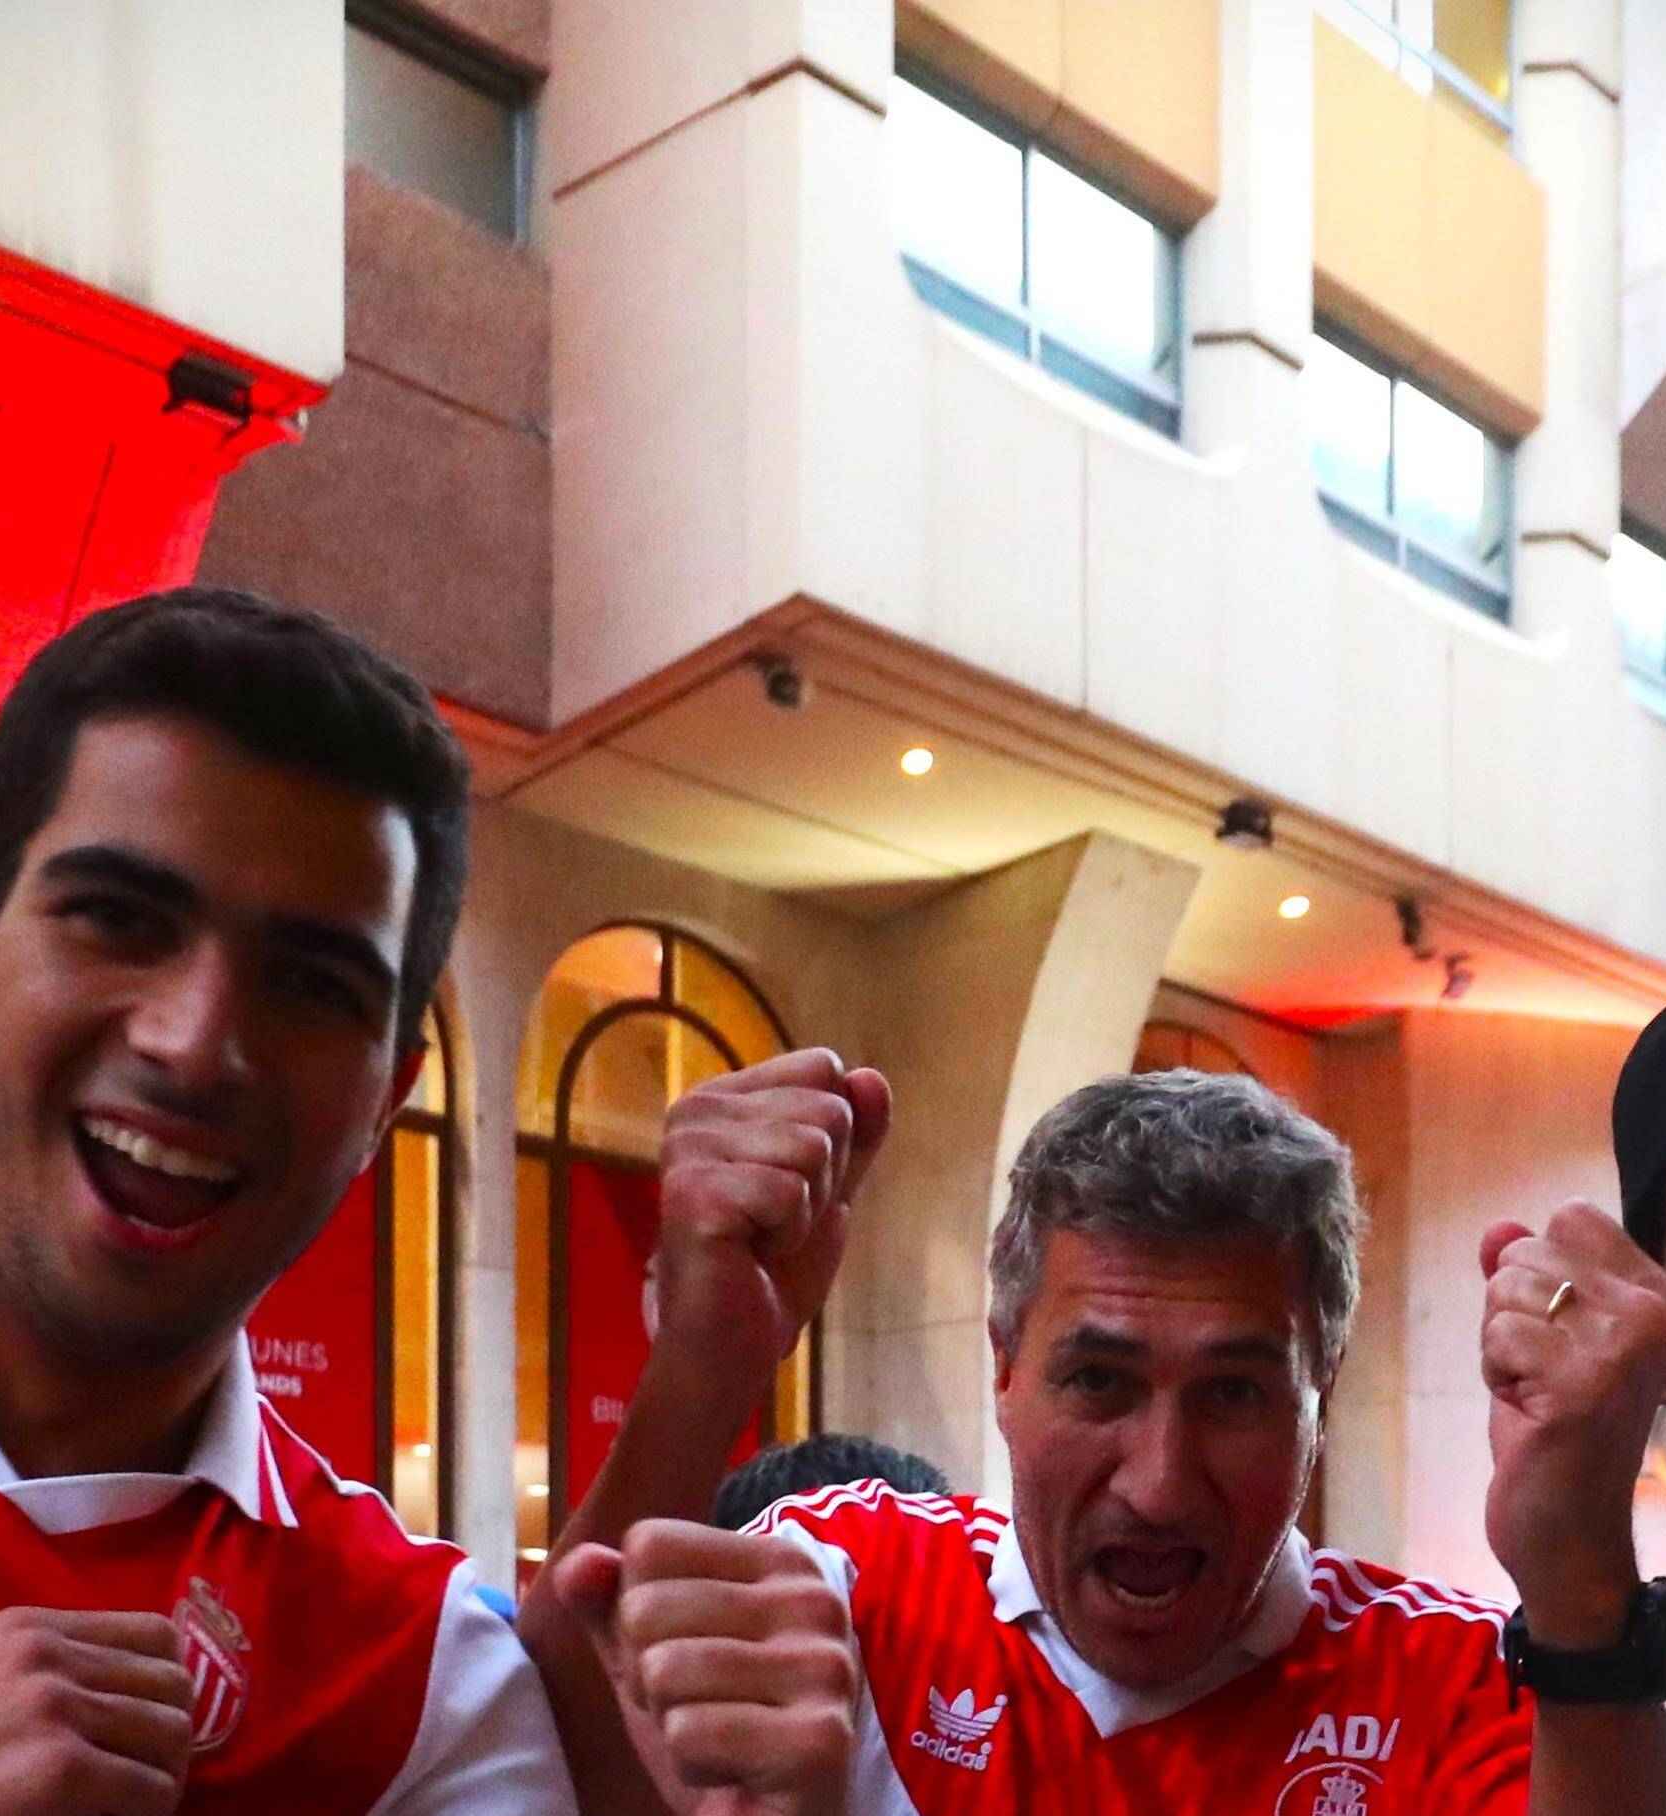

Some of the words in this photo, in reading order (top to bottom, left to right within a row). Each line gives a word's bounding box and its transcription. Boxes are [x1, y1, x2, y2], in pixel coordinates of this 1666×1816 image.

[249, 1335, 329, 1372] UNES
[257, 1373, 302, 1397] NDS
[910, 1731, 988, 1772] adidas
